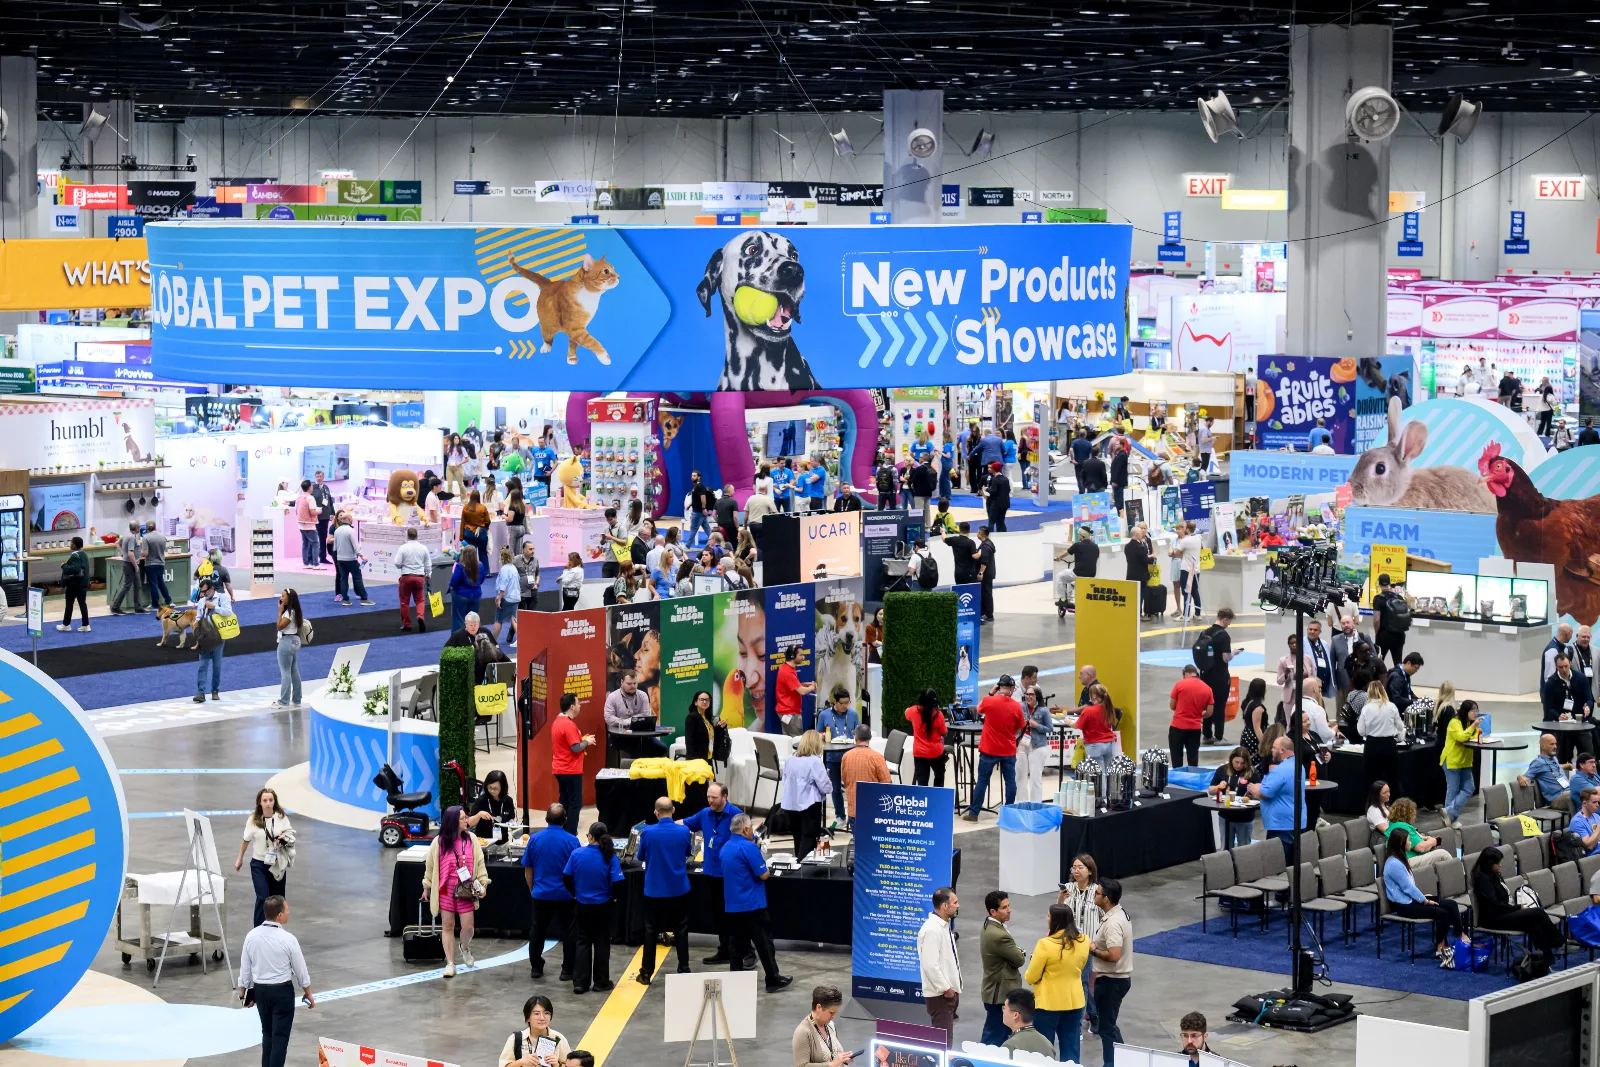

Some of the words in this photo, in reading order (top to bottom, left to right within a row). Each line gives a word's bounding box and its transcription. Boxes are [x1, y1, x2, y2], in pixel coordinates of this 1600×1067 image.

[38, 174, 58, 187] XIT
[1189, 178, 1227, 195] EXIT
[1539, 180, 1580, 198] EXIT
[840, 191, 874, 202] SIMPLE
[114, 229, 137, 237] 2900
[62, 260, 151, 287] WHAT'S
[851, 261, 967, 308] New
[981, 256, 1117, 304] Products
[151, 276, 237, 331] LOBAL
[243, 276, 340, 330] PET
[354, 276, 540, 333] EXPO
[955, 316, 1118, 365] Showcase
[124, 370, 153, 379] PawView
[1275, 370, 1334, 406] fruit
[1281, 398, 1336, 425] ables
[51, 416, 105, 441] humbl
[1356, 416, 1389, 429] RAISING
[1243, 464, 1315, 482] MODERN
[1319, 468, 1350, 483] PET
[809, 521, 852, 540] UCARI
[1360, 521, 1420, 542] FARM
[780, 592, 801, 602] REAL
[1093, 587, 1119, 596] REAL
[729, 599, 750, 608] REAL
[775, 598, 807, 610] REASON
[1086, 593, 1127, 604] REASON
[677, 606, 698, 614] REAL
[724, 605, 756, 616] REASON
[623, 612, 643, 621] REAL
[670, 612, 704, 623] REASON
[567, 619, 589, 629] REAL
[616, 619, 650, 630] REASON
[560, 626, 595, 636] REASON
[478, 690, 505, 703] woof
[893, 795, 928, 808] Global
[895, 806, 907, 815] Pet
[907, 808, 927, 818] Expo
[874, 817, 911, 827] SPOTLIGHT
[912, 820, 934, 829] STAGE
[886, 826, 921, 835] SCHEDULE
[871, 835, 907, 845] WEDNESDAY,
[908, 838, 928, 846] MARCH
